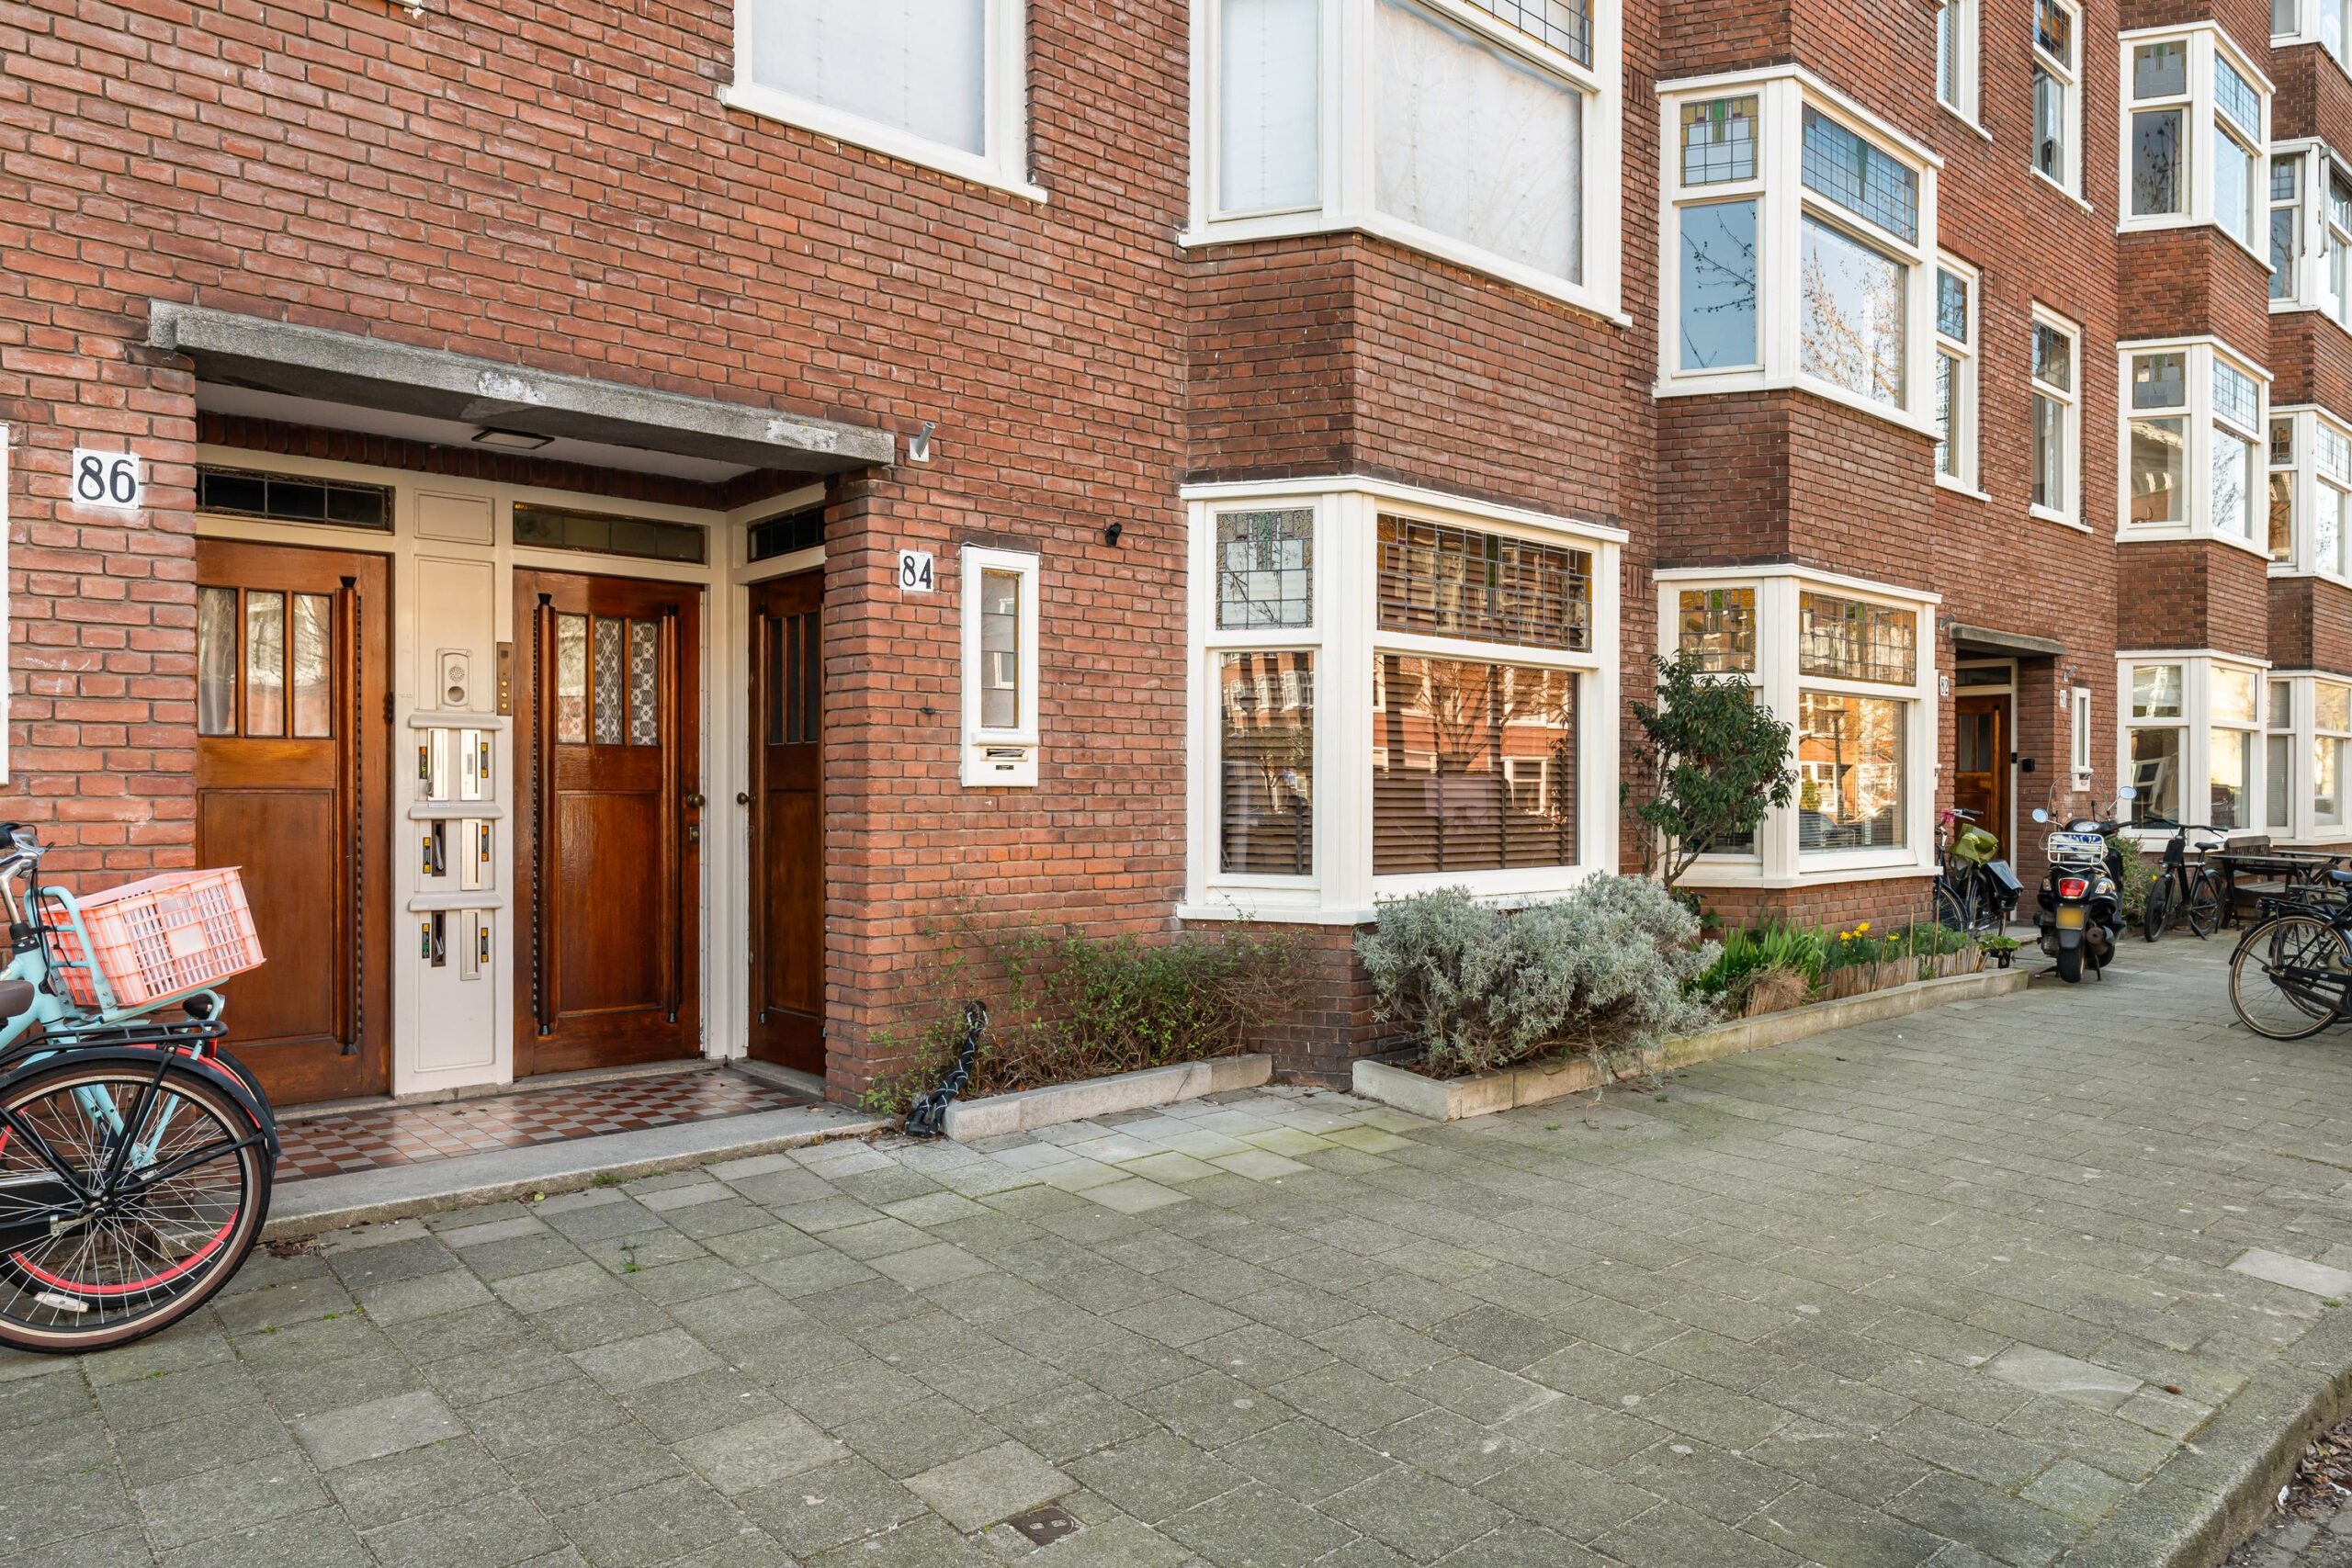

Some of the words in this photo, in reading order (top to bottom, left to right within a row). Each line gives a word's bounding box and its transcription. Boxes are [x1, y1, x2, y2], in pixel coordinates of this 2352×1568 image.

[78, 456, 136, 503] 86
[903, 556, 932, 589] 84
[1941, 678, 1949, 694] 82
